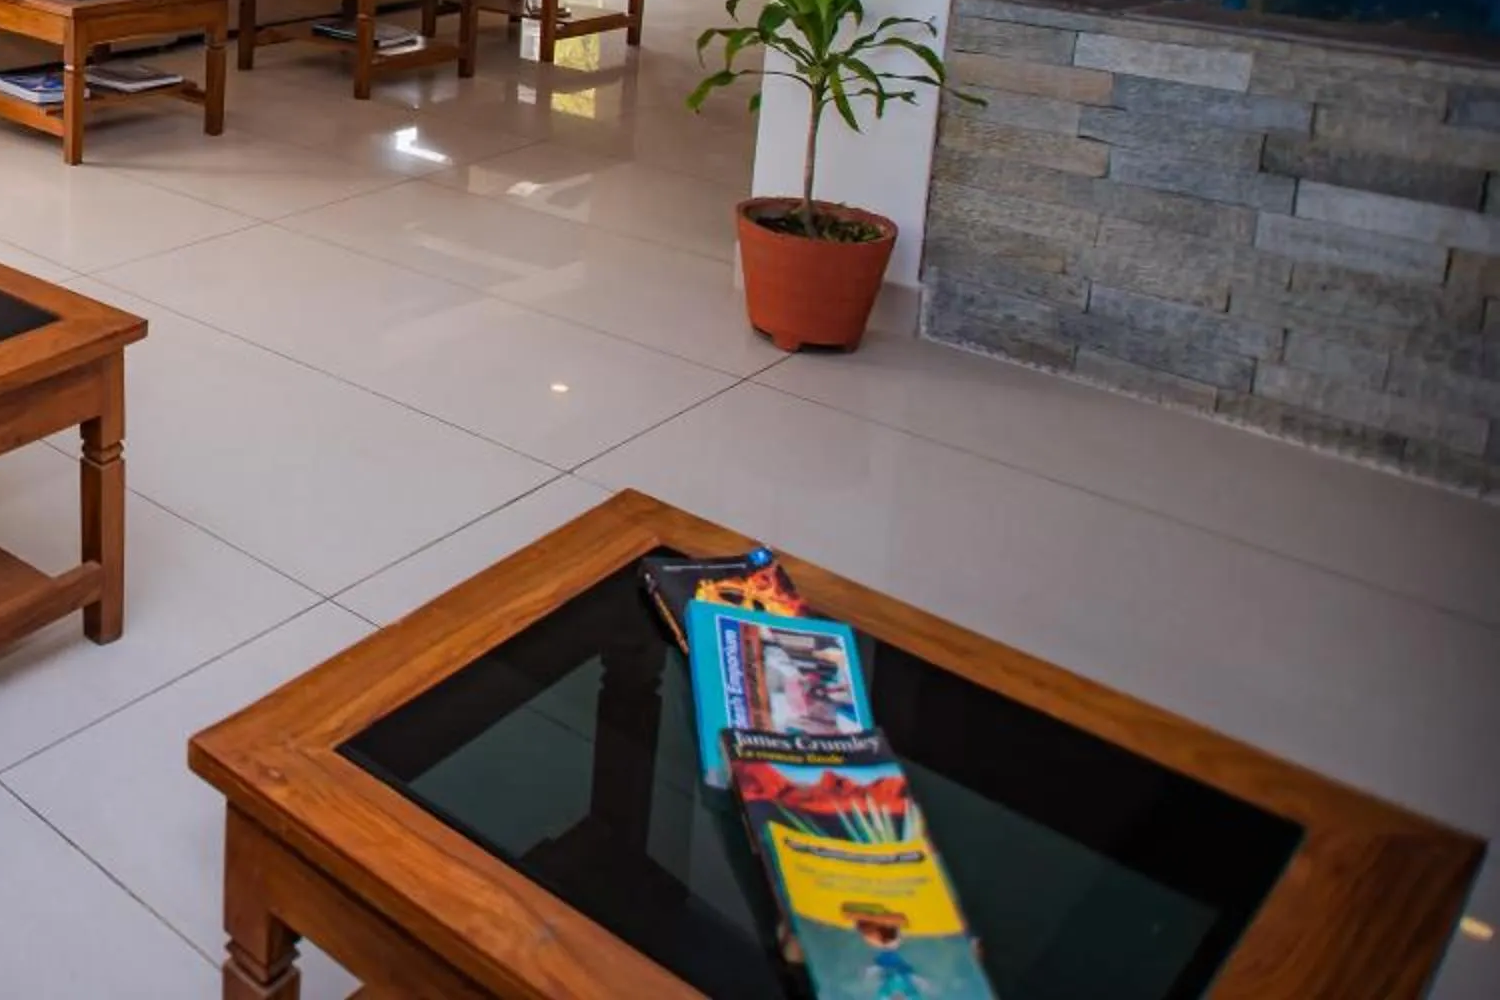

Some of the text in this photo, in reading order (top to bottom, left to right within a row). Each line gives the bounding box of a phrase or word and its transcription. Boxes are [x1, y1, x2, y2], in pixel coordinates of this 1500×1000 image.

[725, 629, 743, 695] Emporium
[734, 731, 880, 753] James Crumley
